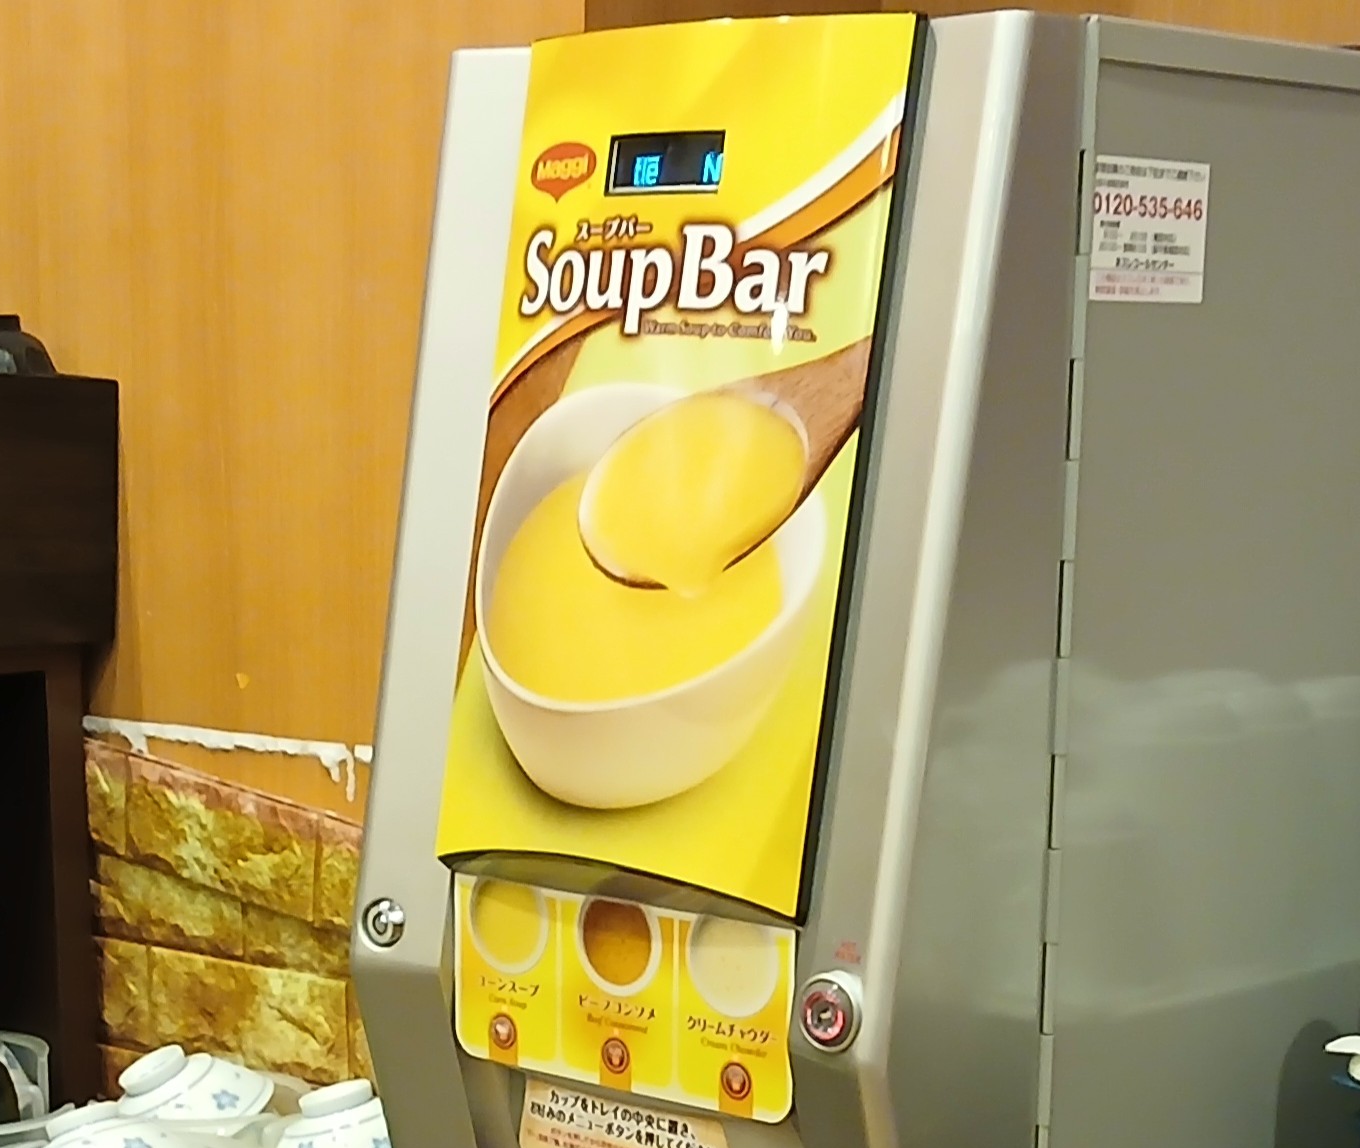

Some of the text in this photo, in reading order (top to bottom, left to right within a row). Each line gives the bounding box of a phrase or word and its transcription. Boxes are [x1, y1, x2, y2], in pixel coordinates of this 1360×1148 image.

[537, 152, 589, 181] Maggi
[1093, 191, 1203, 221] 0120-535-646
[575, 216, 653, 241] スープバー
[520, 224, 829, 335] Soup Bar
[728, 322, 784, 340] Comfo
[480, 975, 540, 997] コーンスープ
[578, 994, 656, 1020] ビーフコンソメ
[687, 1014, 778, 1043] クリームチャウダー
